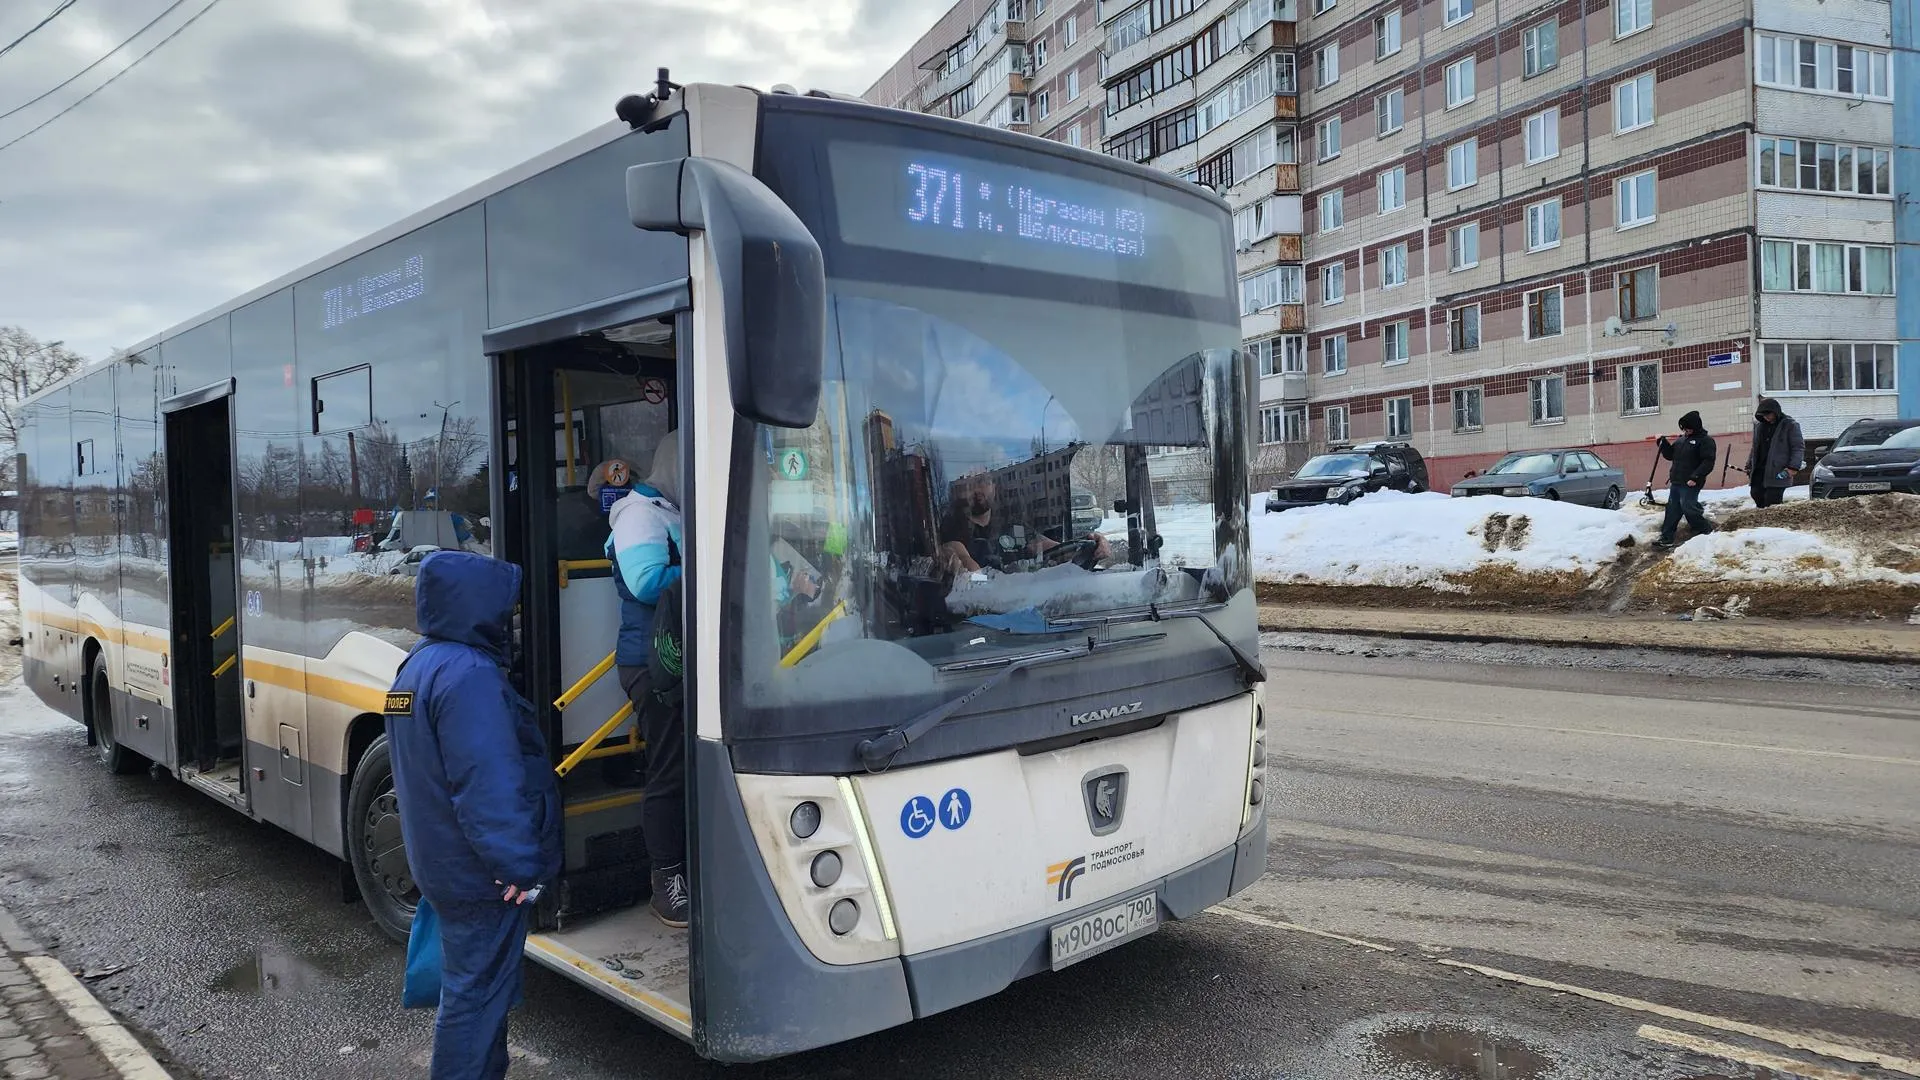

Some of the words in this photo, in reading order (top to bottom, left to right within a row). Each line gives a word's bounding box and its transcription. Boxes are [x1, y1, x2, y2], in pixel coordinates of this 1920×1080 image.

[907, 163, 964, 229] 371
[1008, 185, 1105, 226] (Магазин
[978, 211, 1003, 232] м.
[1071, 701, 1143, 726] KAMAZ
[1090, 848, 1145, 872] ПОДМОСКОВЬЯ
[1091, 842, 1133, 861] ТРАНСПОРТ
[1128, 897, 1152, 922] 790
